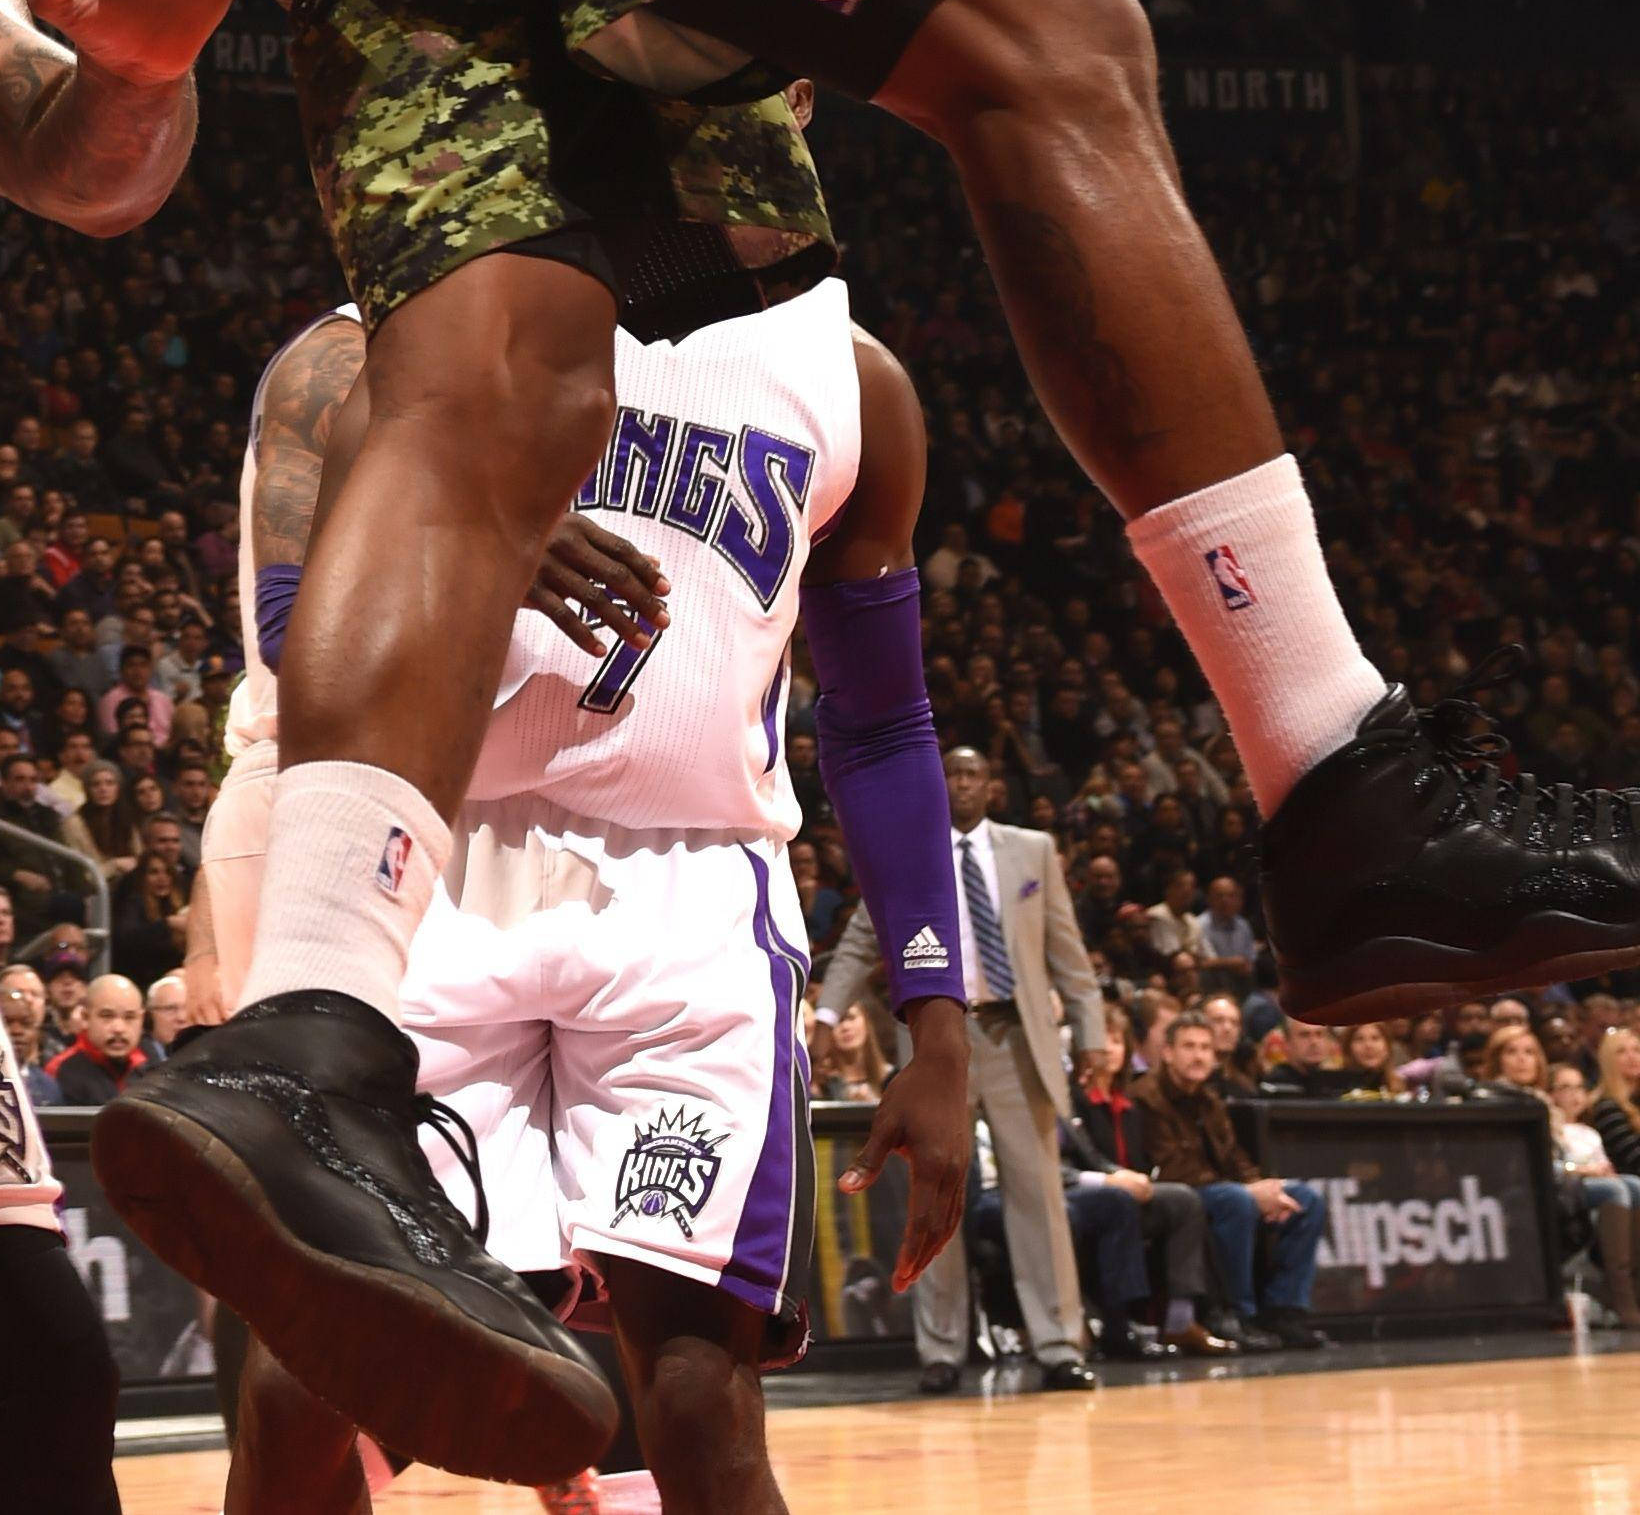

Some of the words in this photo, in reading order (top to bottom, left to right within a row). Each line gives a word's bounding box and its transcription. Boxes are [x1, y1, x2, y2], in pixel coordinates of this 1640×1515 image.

[1184, 68, 1329, 110] NORTH
[902, 946, 948, 958] adidas
[619, 1152, 715, 1208] KINGS
